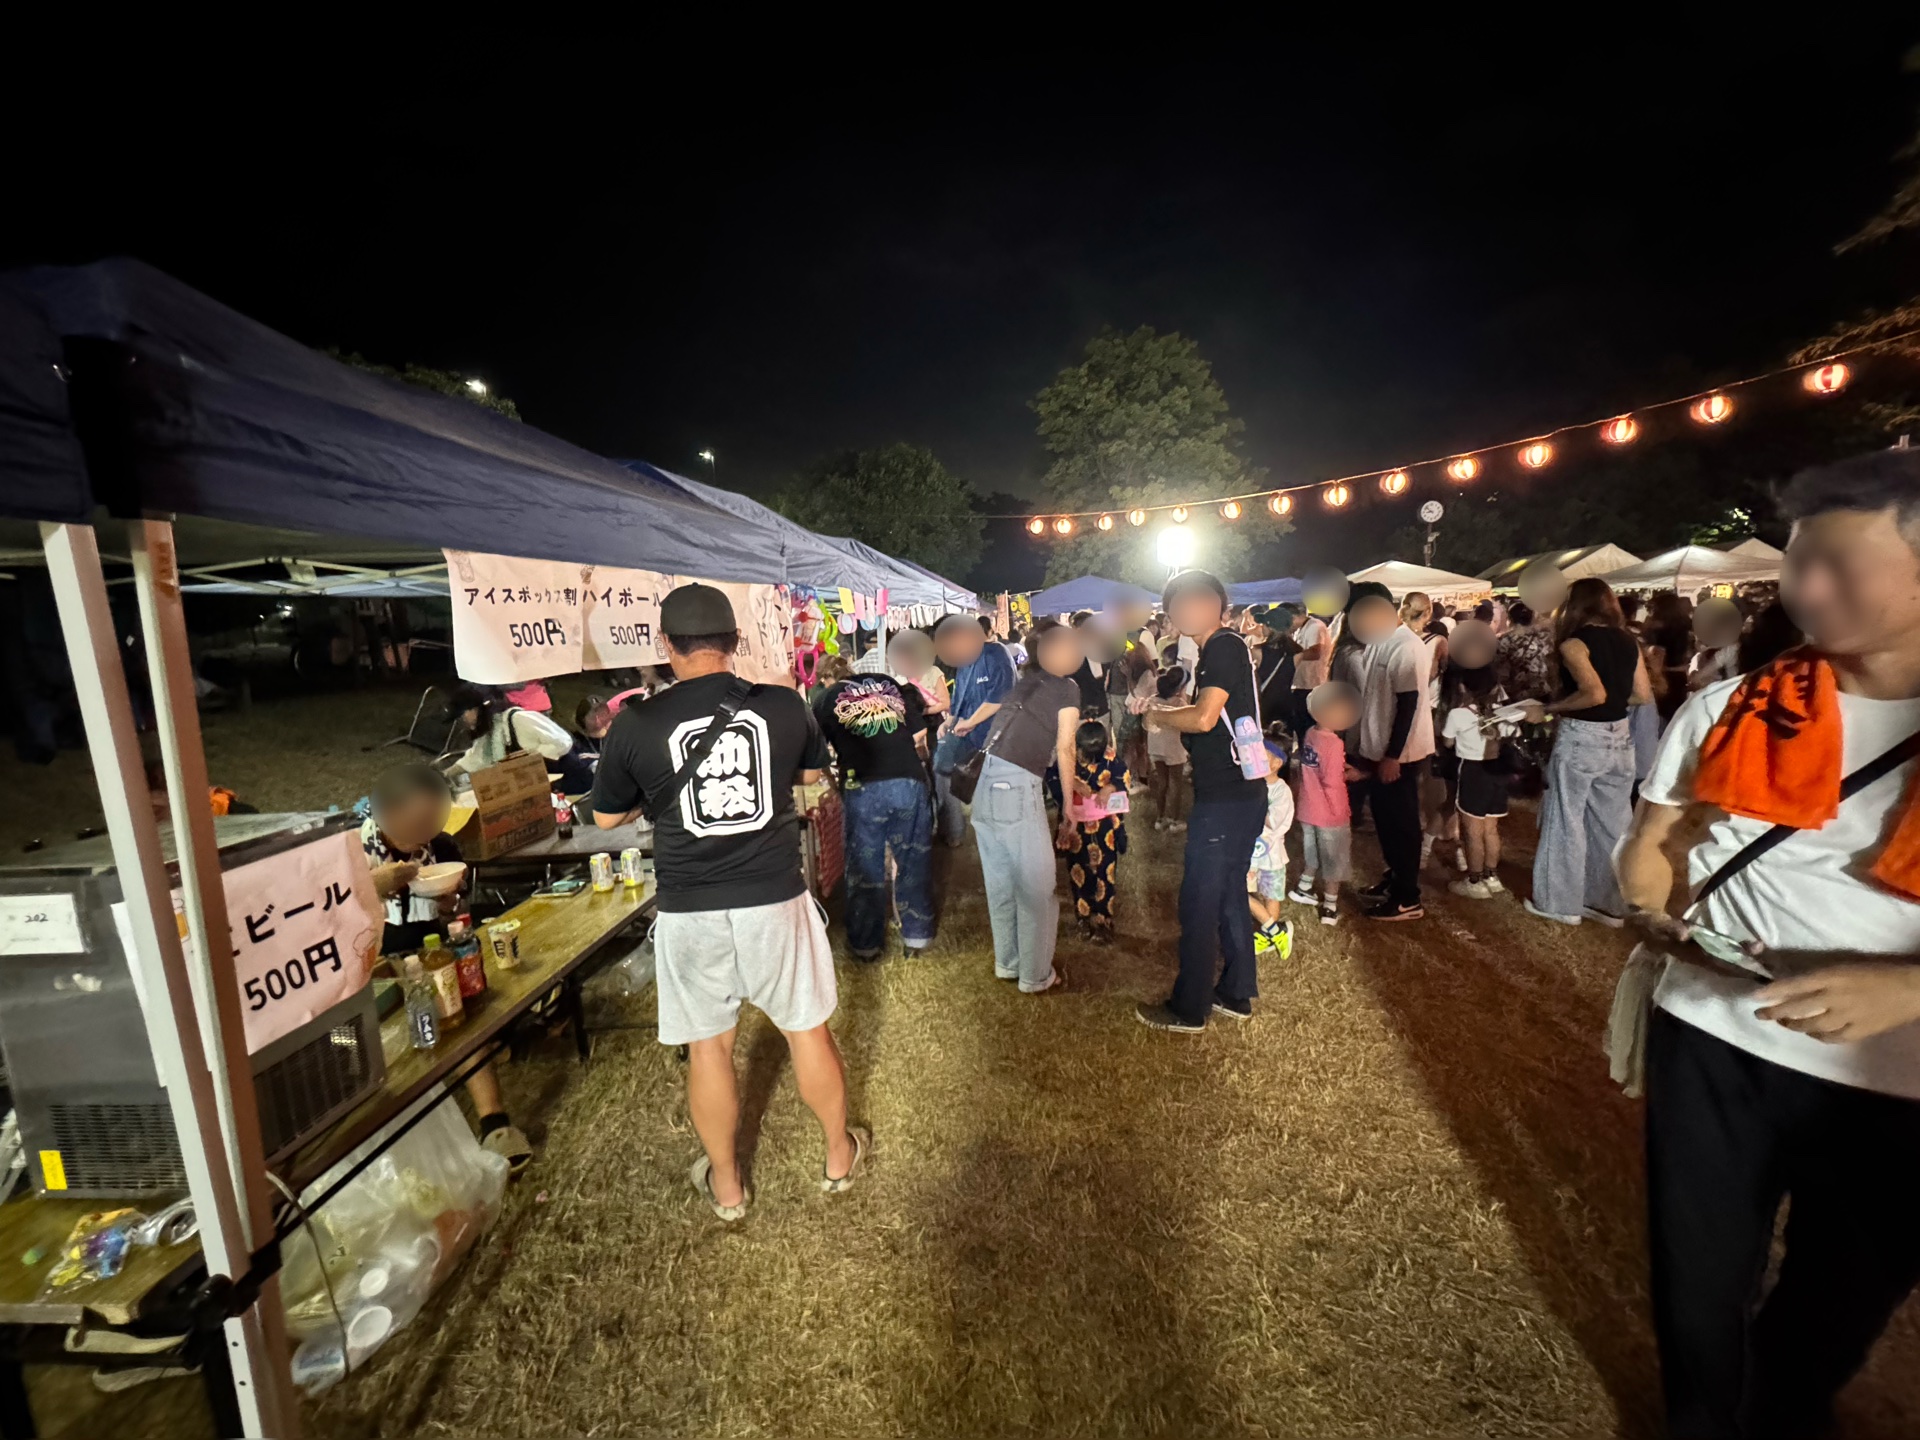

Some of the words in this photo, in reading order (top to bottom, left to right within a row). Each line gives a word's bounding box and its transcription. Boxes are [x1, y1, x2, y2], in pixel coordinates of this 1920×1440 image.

[463, 586, 577, 607] アイスボックス割
[582, 586, 661, 608] ハイボール
[509, 617, 567, 648] 500円
[609, 623, 652, 646] 500円
[24, 912, 48, 923] 202
[229, 881, 352, 957] ビール
[244, 936, 342, 1011] 500円
